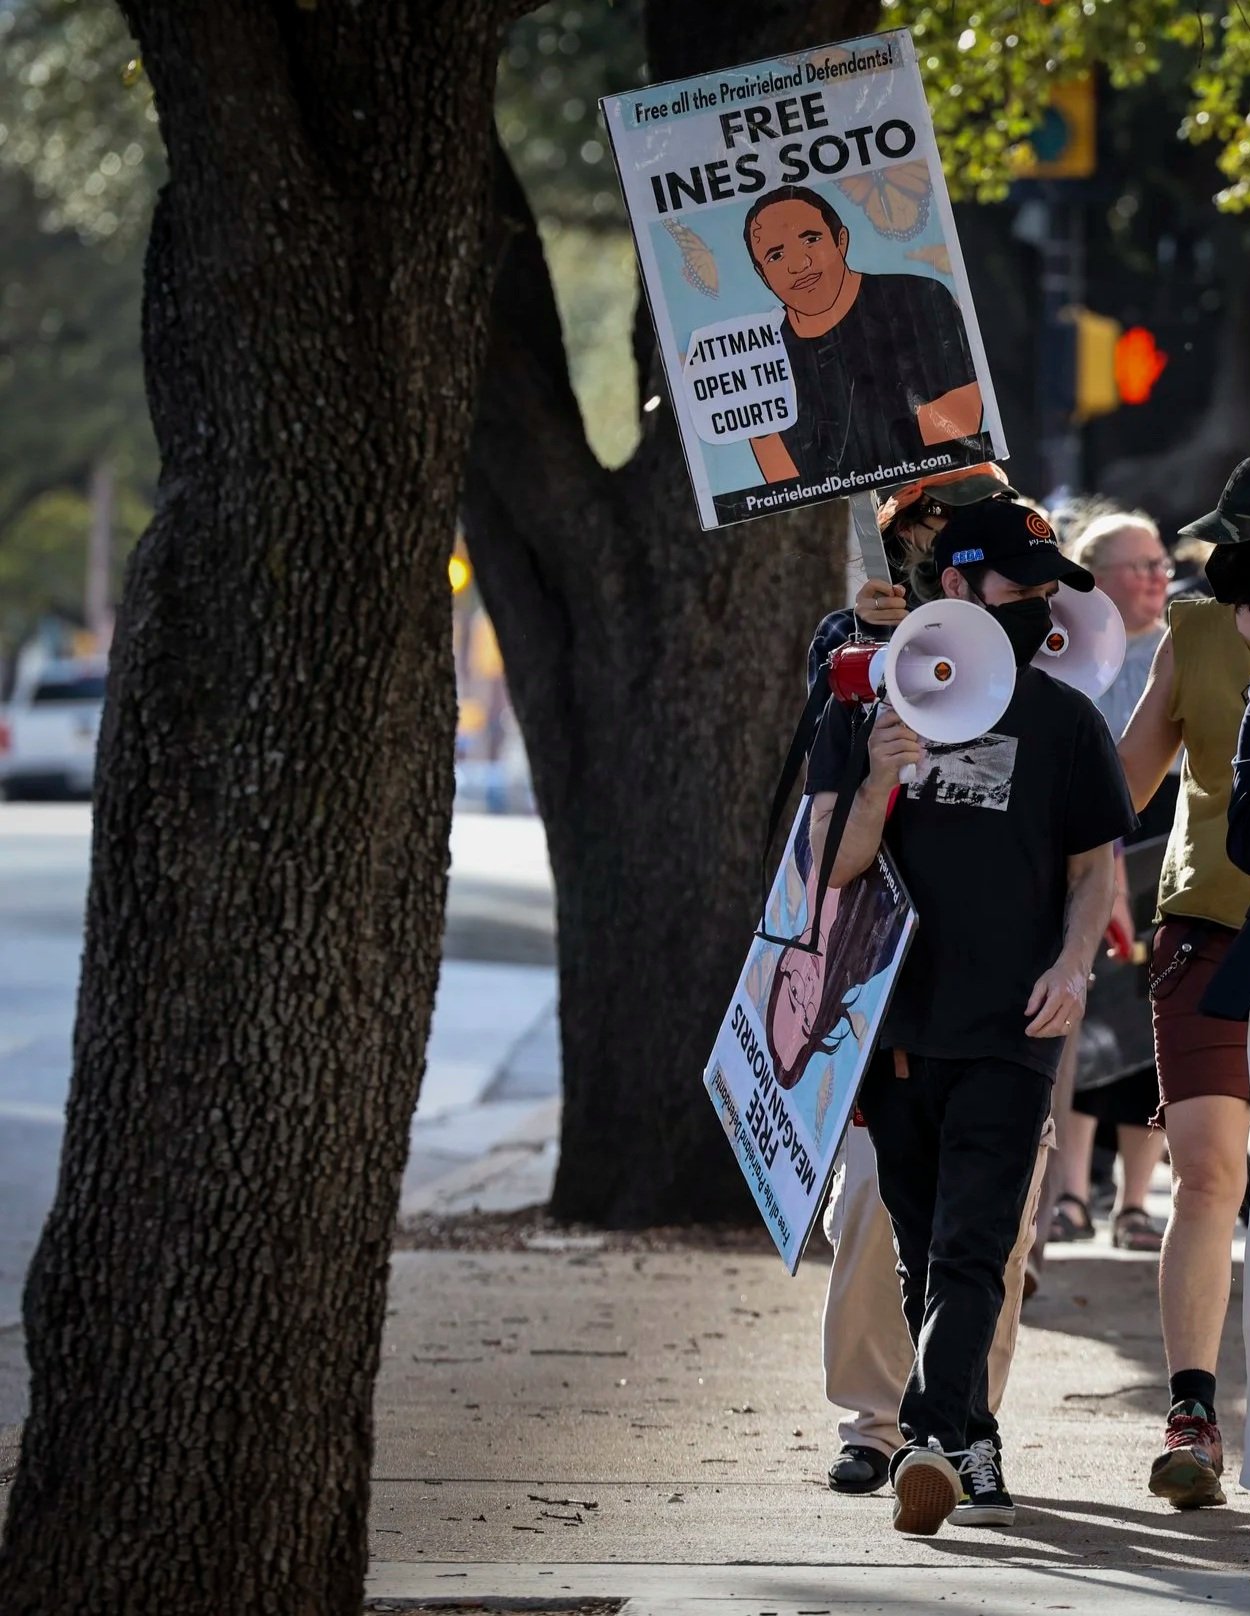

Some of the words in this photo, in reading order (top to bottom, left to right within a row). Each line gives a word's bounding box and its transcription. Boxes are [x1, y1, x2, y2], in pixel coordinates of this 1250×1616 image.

[634, 99, 668, 124] Free
[671, 91, 691, 115] all
[692, 85, 717, 109] the
[719, 64, 803, 103] Prairieland
[804, 43, 894, 84] Defendants!
[719, 91, 829, 149] FREE
[651, 153, 767, 214] INES
[778, 119, 917, 184] SOTO
[693, 368, 748, 402] OPEN
[750, 358, 789, 387] THE
[711, 396, 789, 435] COURTS
[745, 452, 952, 511] PrairielandDefendants.com
[952, 548, 984, 566] SEGA
[731, 1003, 774, 1099] MORRIS
[745, 1087, 779, 1170] FREE
[768, 1086, 817, 1196] MEAGAN
[737, 1128, 767, 1192] Prairieland
[763, 1184, 774, 1208] the
[768, 1201, 780, 1219] all
[778, 1215, 791, 1248] Free
